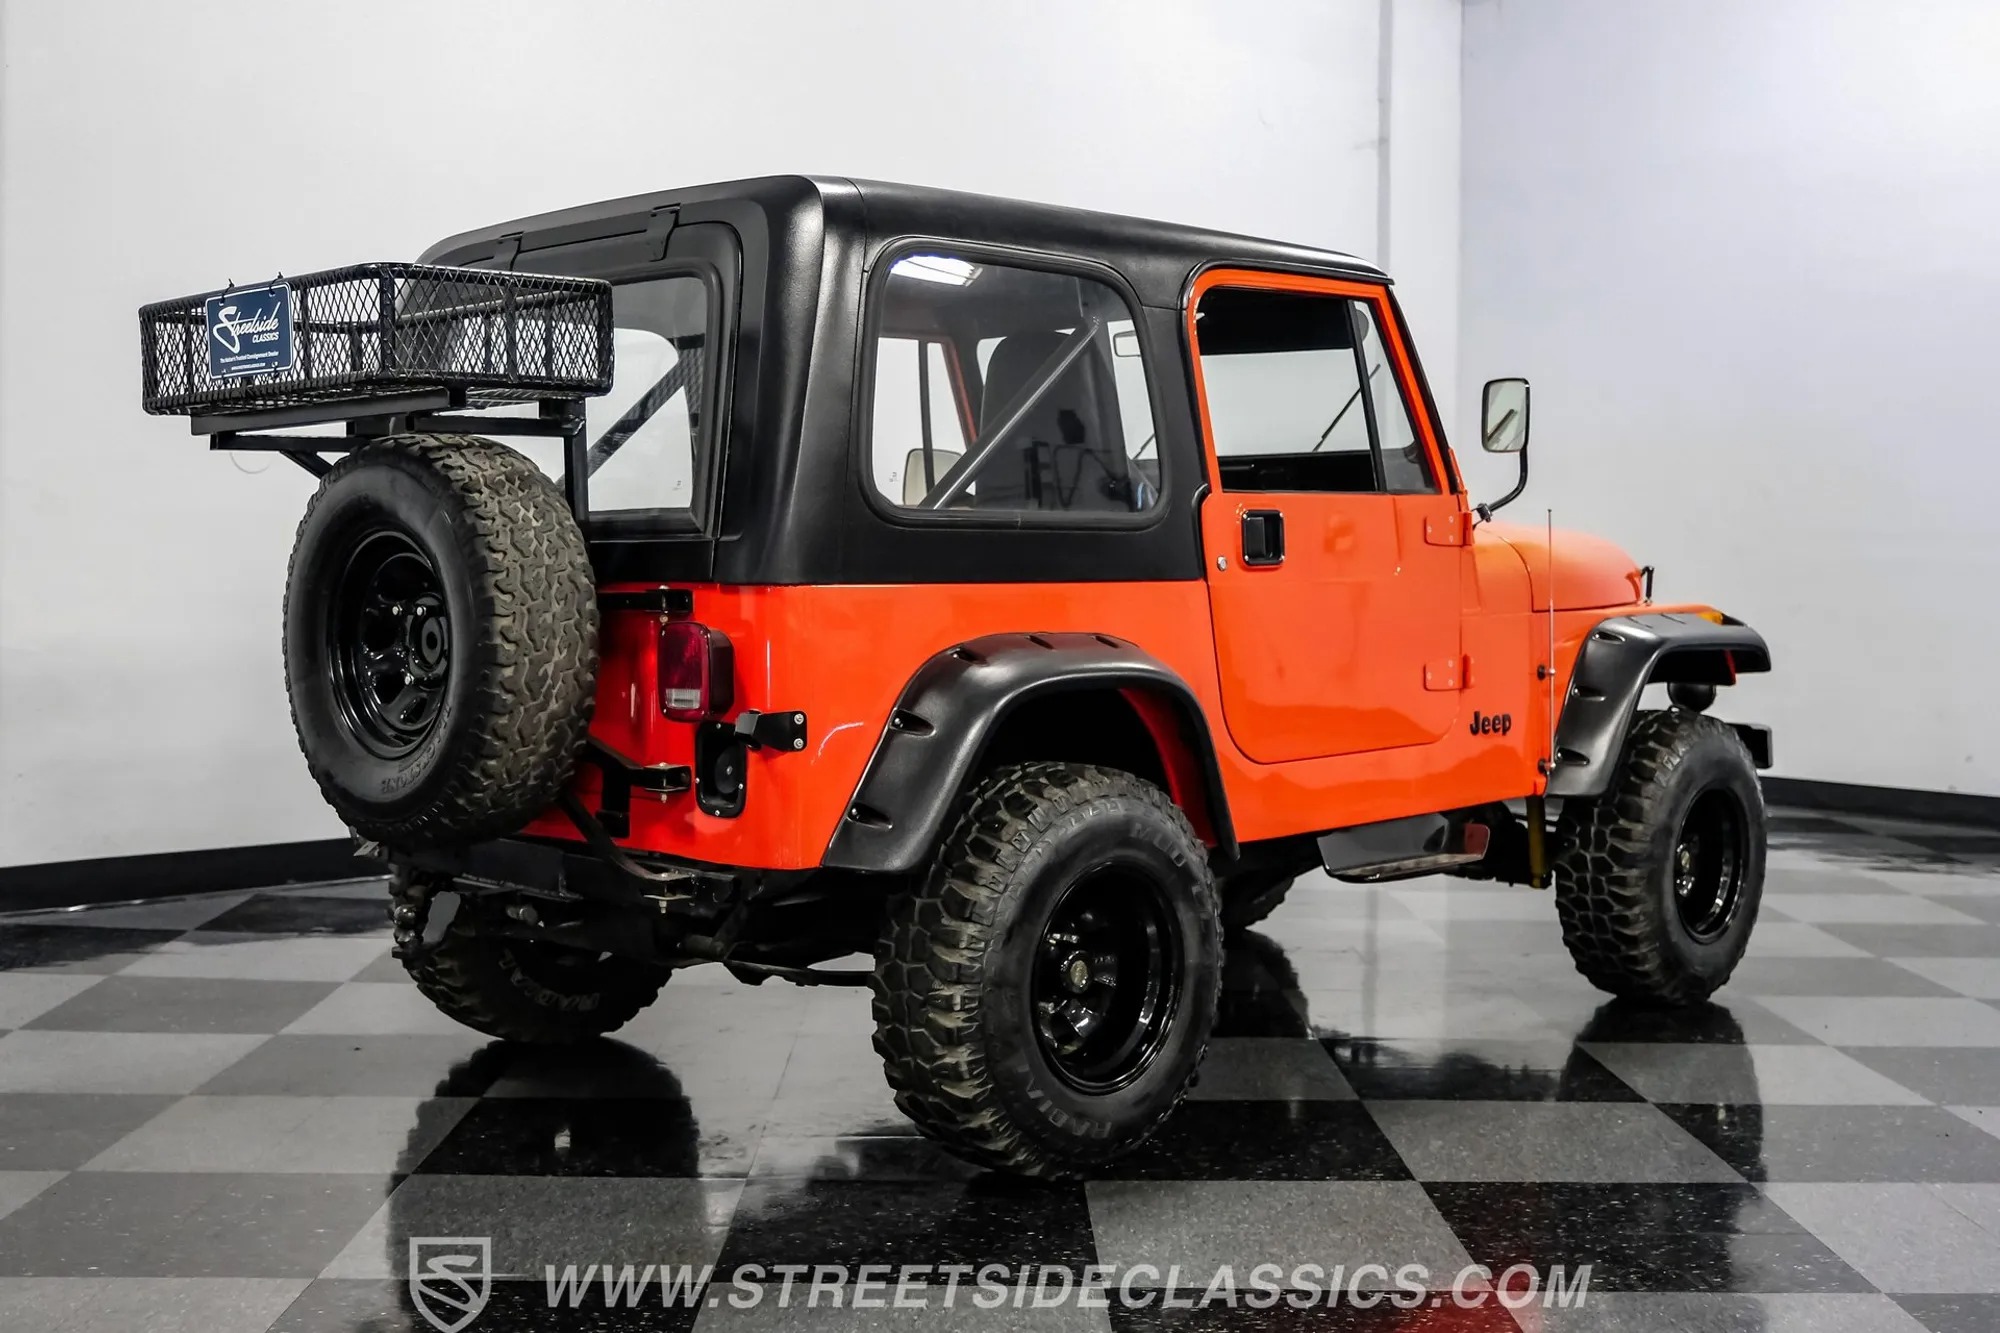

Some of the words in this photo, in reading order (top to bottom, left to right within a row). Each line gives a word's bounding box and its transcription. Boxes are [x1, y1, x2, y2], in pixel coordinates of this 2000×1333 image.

[213, 302, 281, 354] Streetside
[252, 332, 279, 344] CLASSICS
[1469, 711, 1512, 736] Jeep
